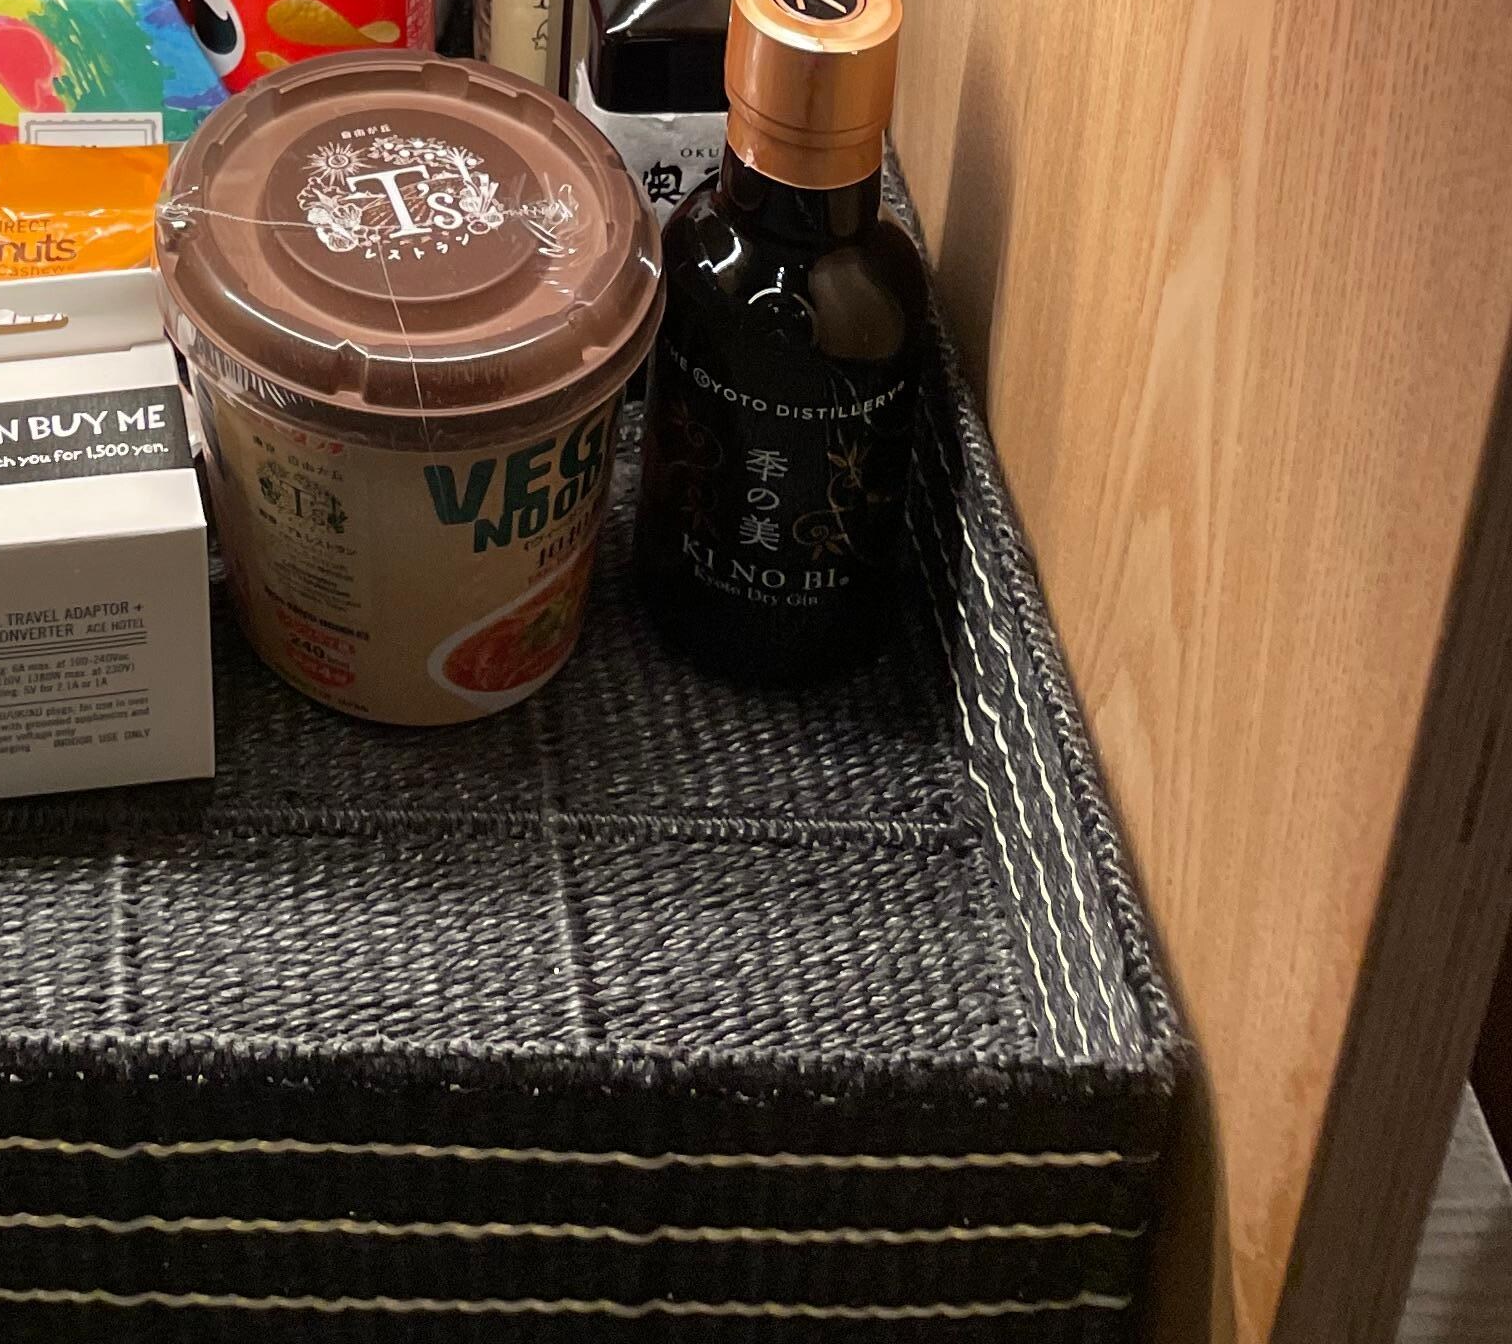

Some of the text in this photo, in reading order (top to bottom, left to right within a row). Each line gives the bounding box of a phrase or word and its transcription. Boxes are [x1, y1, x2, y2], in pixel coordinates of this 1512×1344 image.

[346, 164, 464, 238] T's
[776, 385, 899, 420] DISTILLERY
[27, 409, 108, 441] BUY
[116, 404, 166, 432] ME
[18, 452, 52, 467] you
[53, 447, 83, 462] for
[739, 448, 789, 551] 季の美
[682, 533, 714, 569] KI
[731, 560, 787, 589] NO
[8, 611, 60, 626] TRAVEL
[65, 601, 130, 620] ADAPTOR
